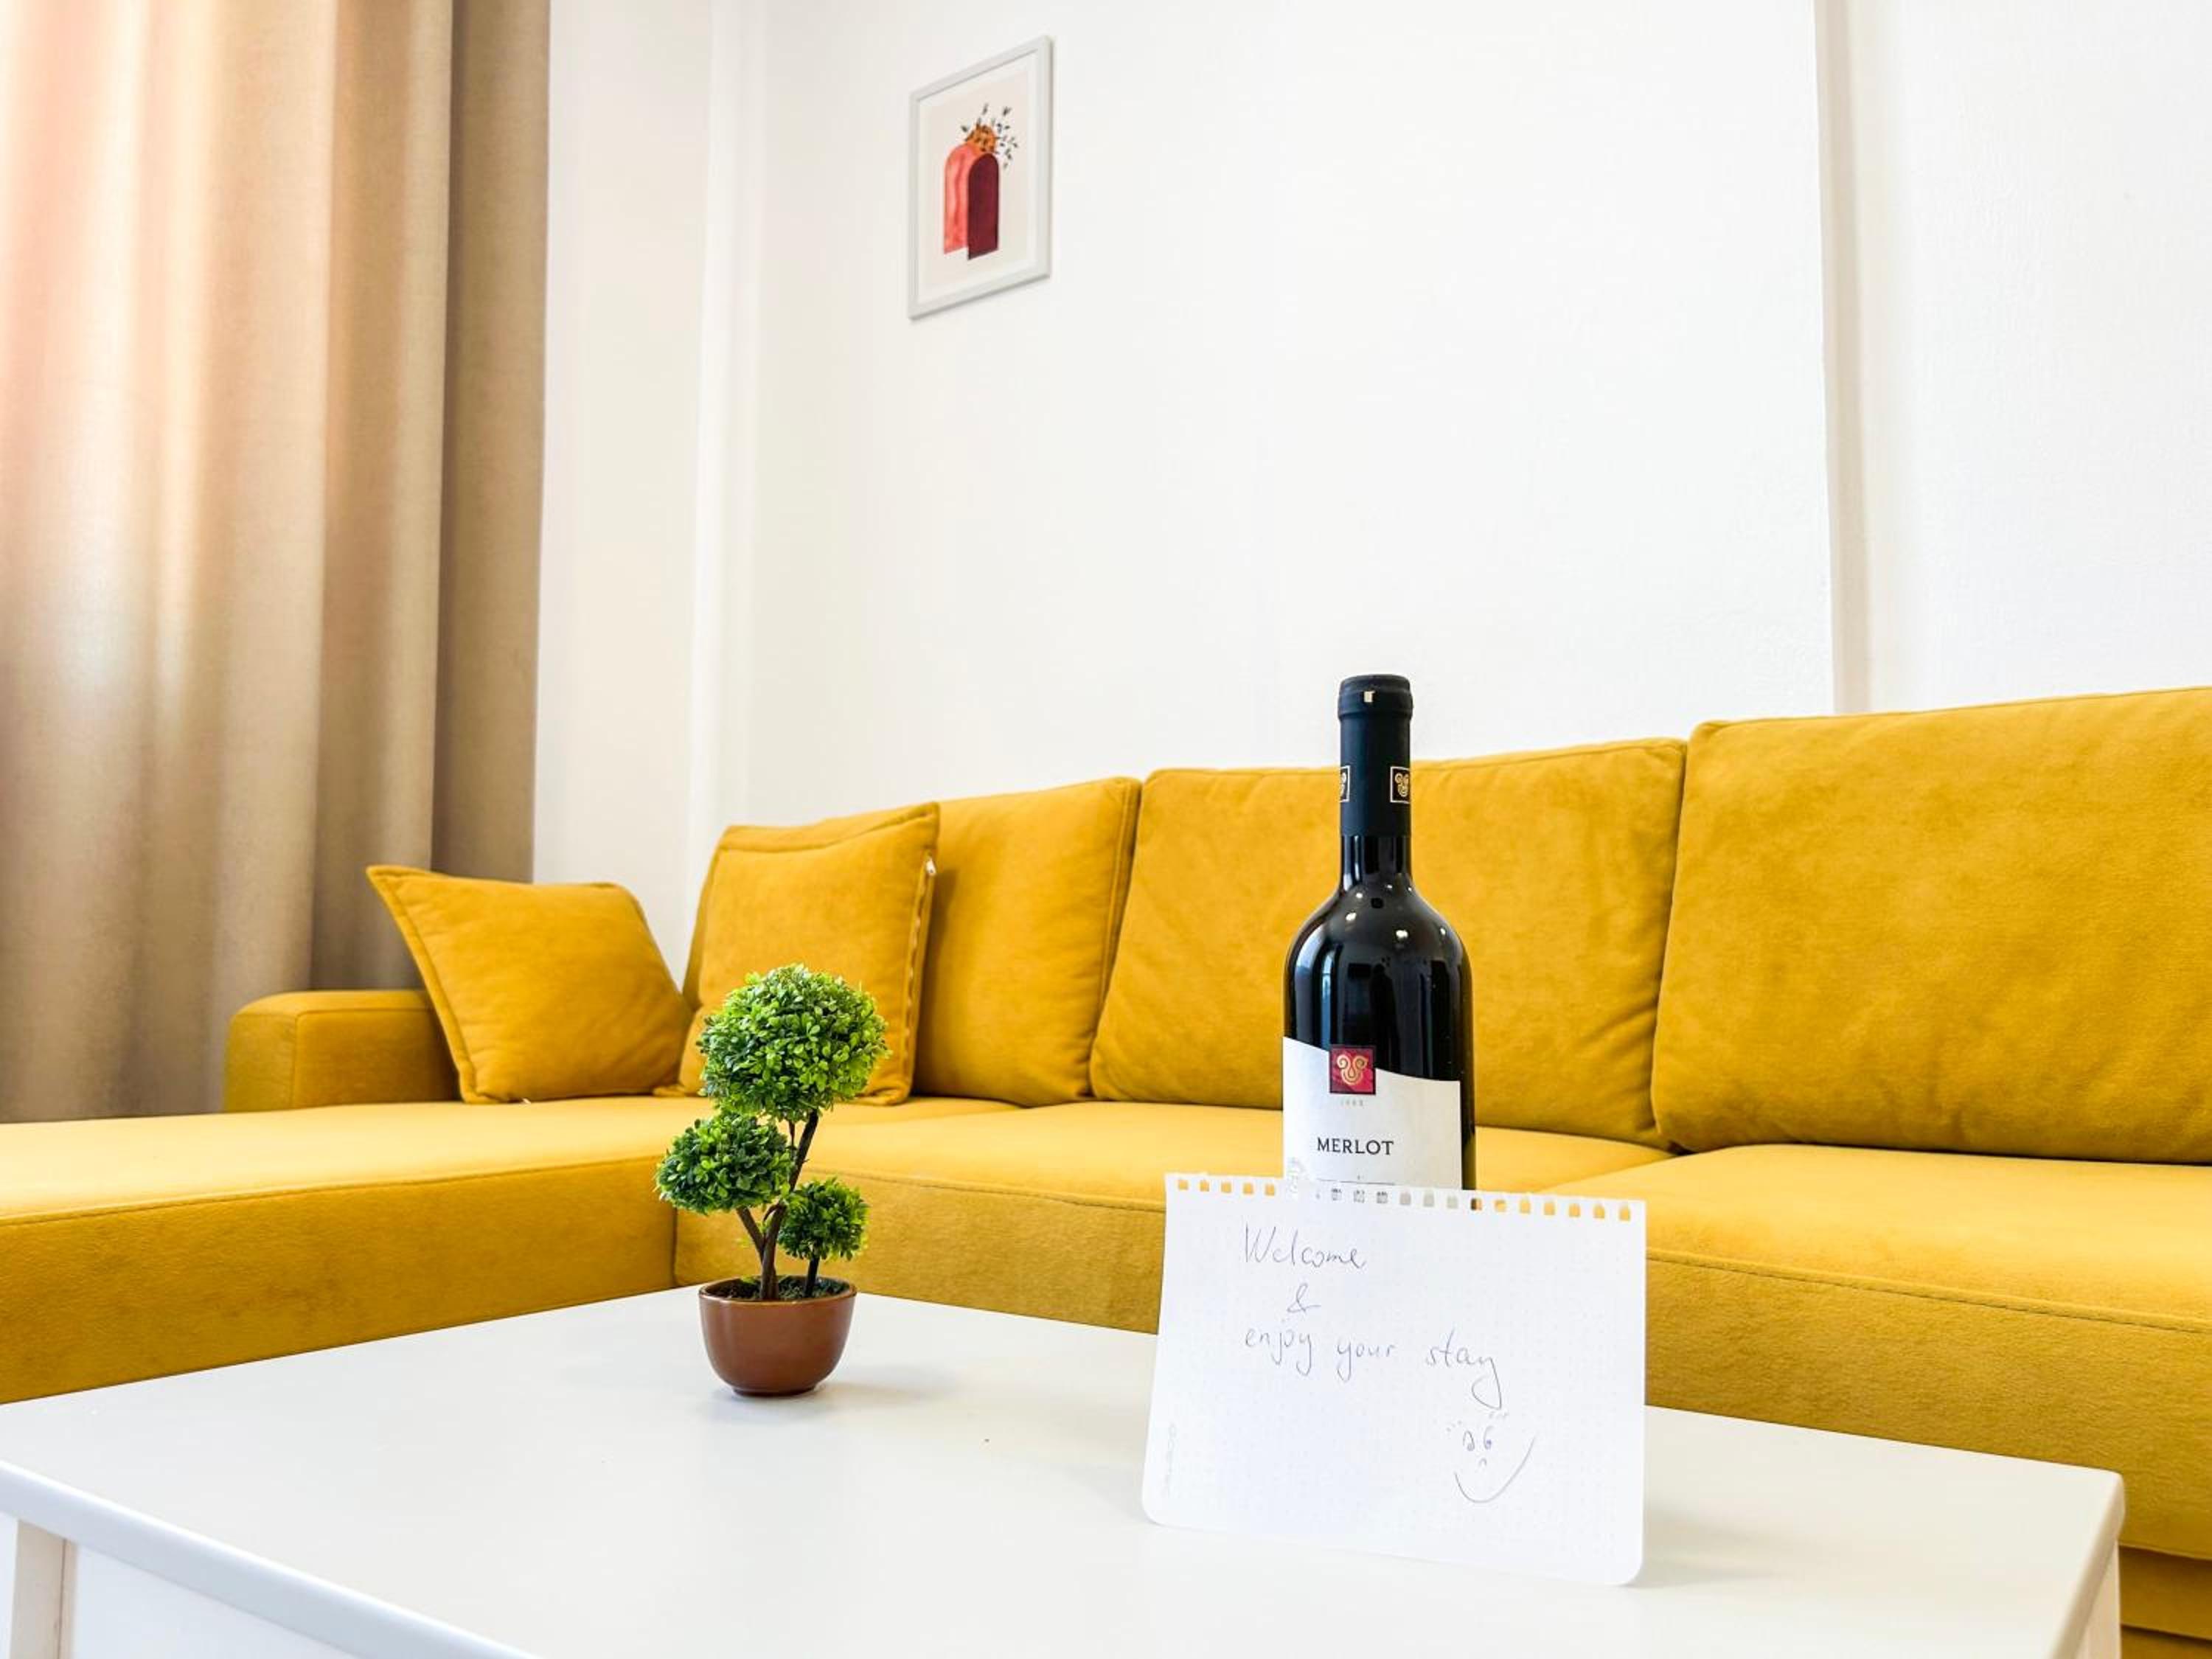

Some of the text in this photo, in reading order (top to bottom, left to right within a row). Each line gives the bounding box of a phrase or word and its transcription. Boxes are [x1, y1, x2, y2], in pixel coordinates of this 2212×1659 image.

[1317, 1137, 1394, 1155] MERLOT
[1245, 1221, 1367, 1269] Welcome
[1286, 1282, 1321, 1315] &
[1245, 1319, 1502, 1411] enjoy your stay
